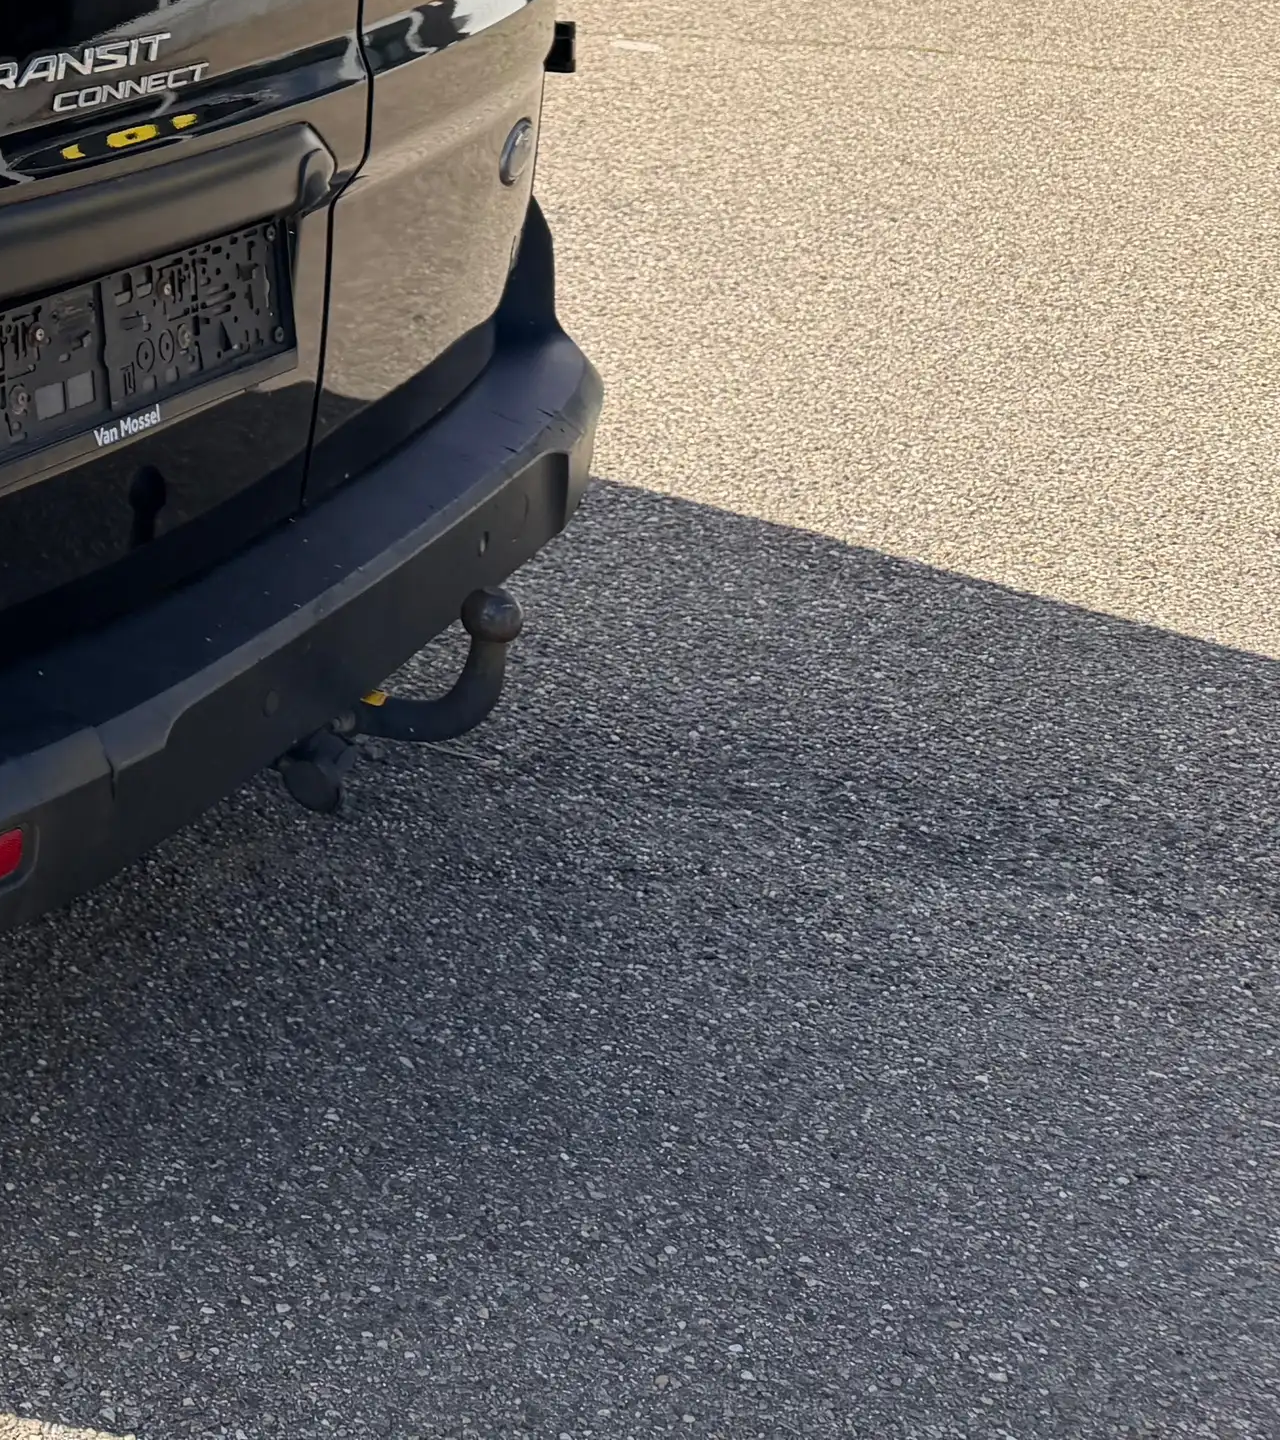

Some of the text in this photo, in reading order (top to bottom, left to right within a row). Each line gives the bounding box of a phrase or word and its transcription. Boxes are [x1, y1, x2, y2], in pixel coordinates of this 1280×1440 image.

[52, 62, 209, 112] CONNECT
[93, 403, 161, 447] Van Mossel
